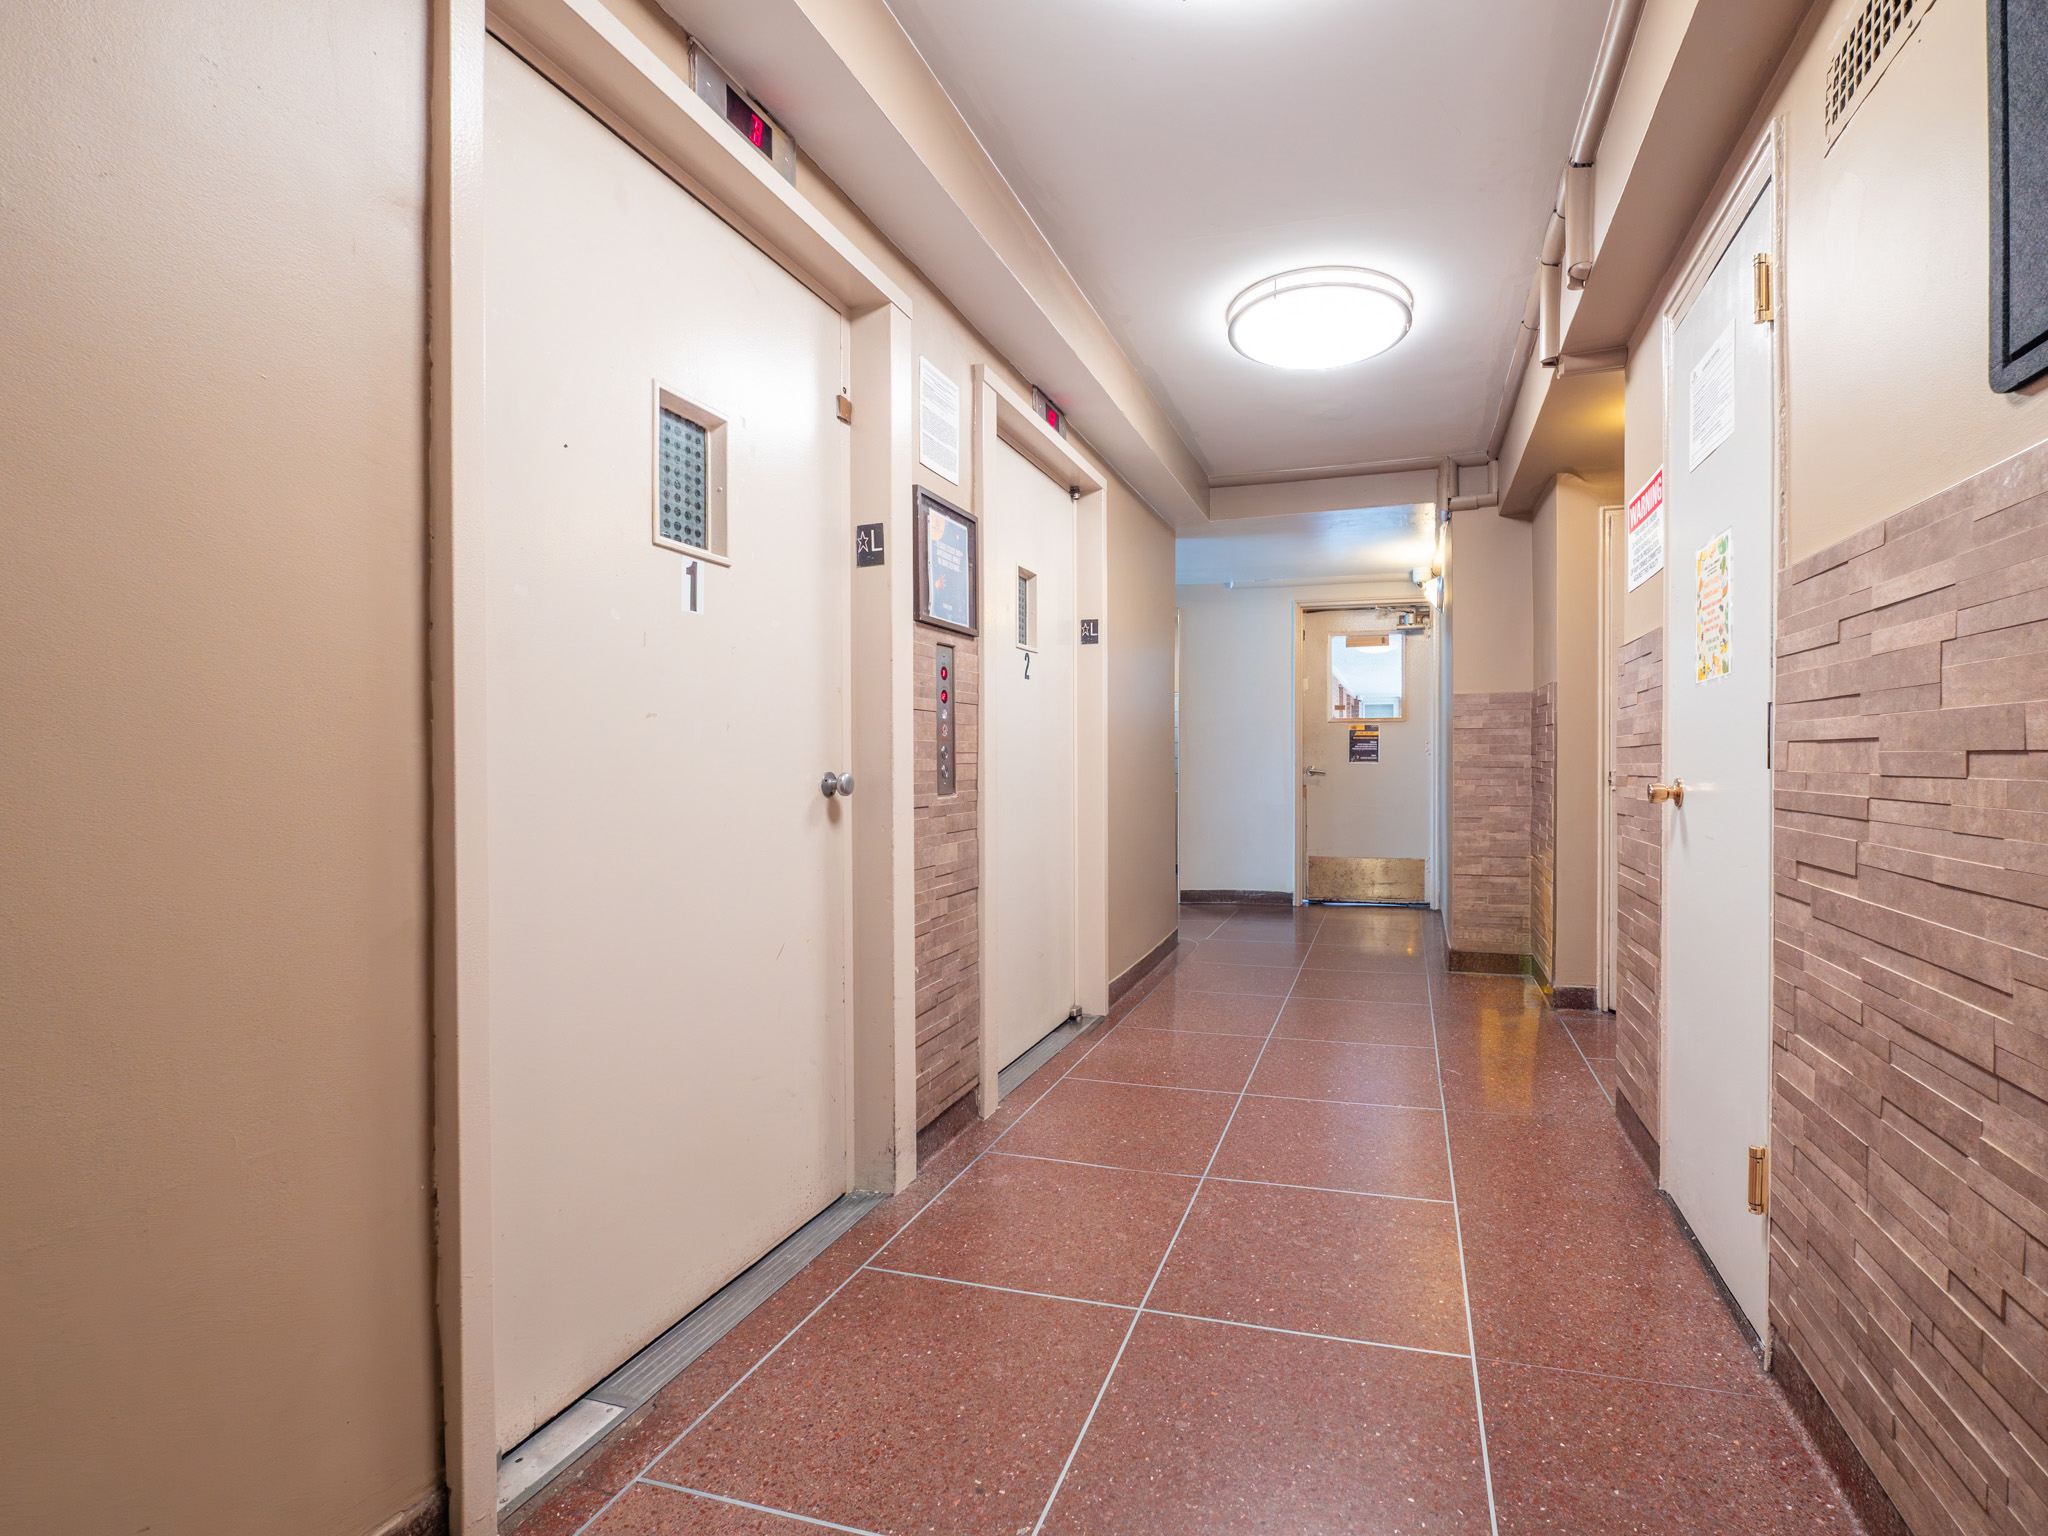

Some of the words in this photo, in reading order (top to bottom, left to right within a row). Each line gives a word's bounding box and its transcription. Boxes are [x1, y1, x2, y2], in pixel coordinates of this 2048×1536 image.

[1630, 475, 1662, 529] WARNING
[871, 529, 883, 551] L
[686, 561, 697, 612] 1
[1090, 622, 1098, 636] L
[1024, 652, 1030, 680] 2
